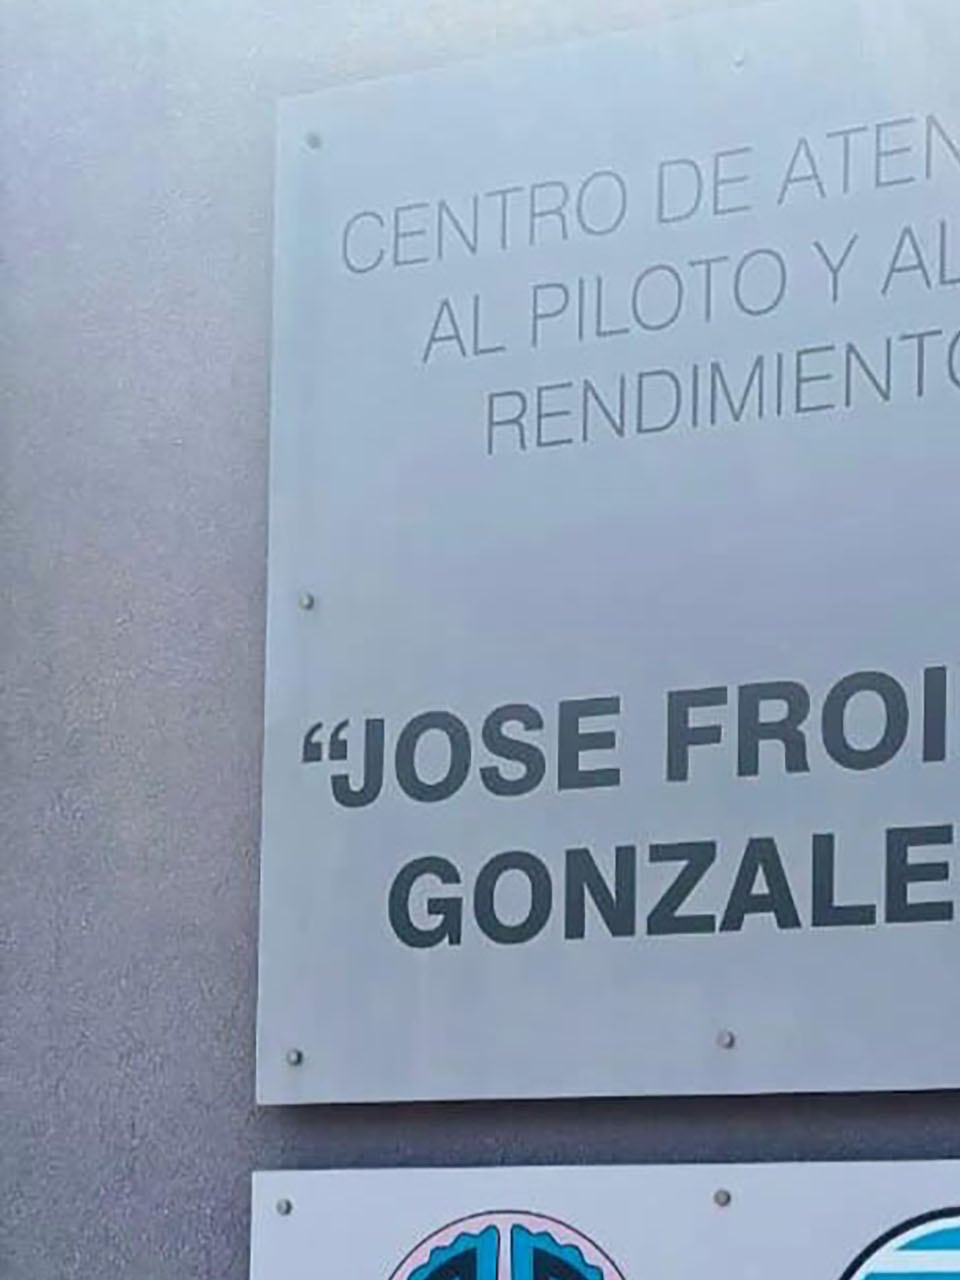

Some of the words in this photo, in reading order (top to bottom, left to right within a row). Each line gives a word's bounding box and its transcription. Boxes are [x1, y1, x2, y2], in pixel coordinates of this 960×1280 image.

[341, 170, 628, 275] CENTRO
[655, 146, 755, 227] DE
[421, 296, 507, 365] AL
[528, 247, 788, 351] PILOTO
[813, 234, 859, 304] Y
